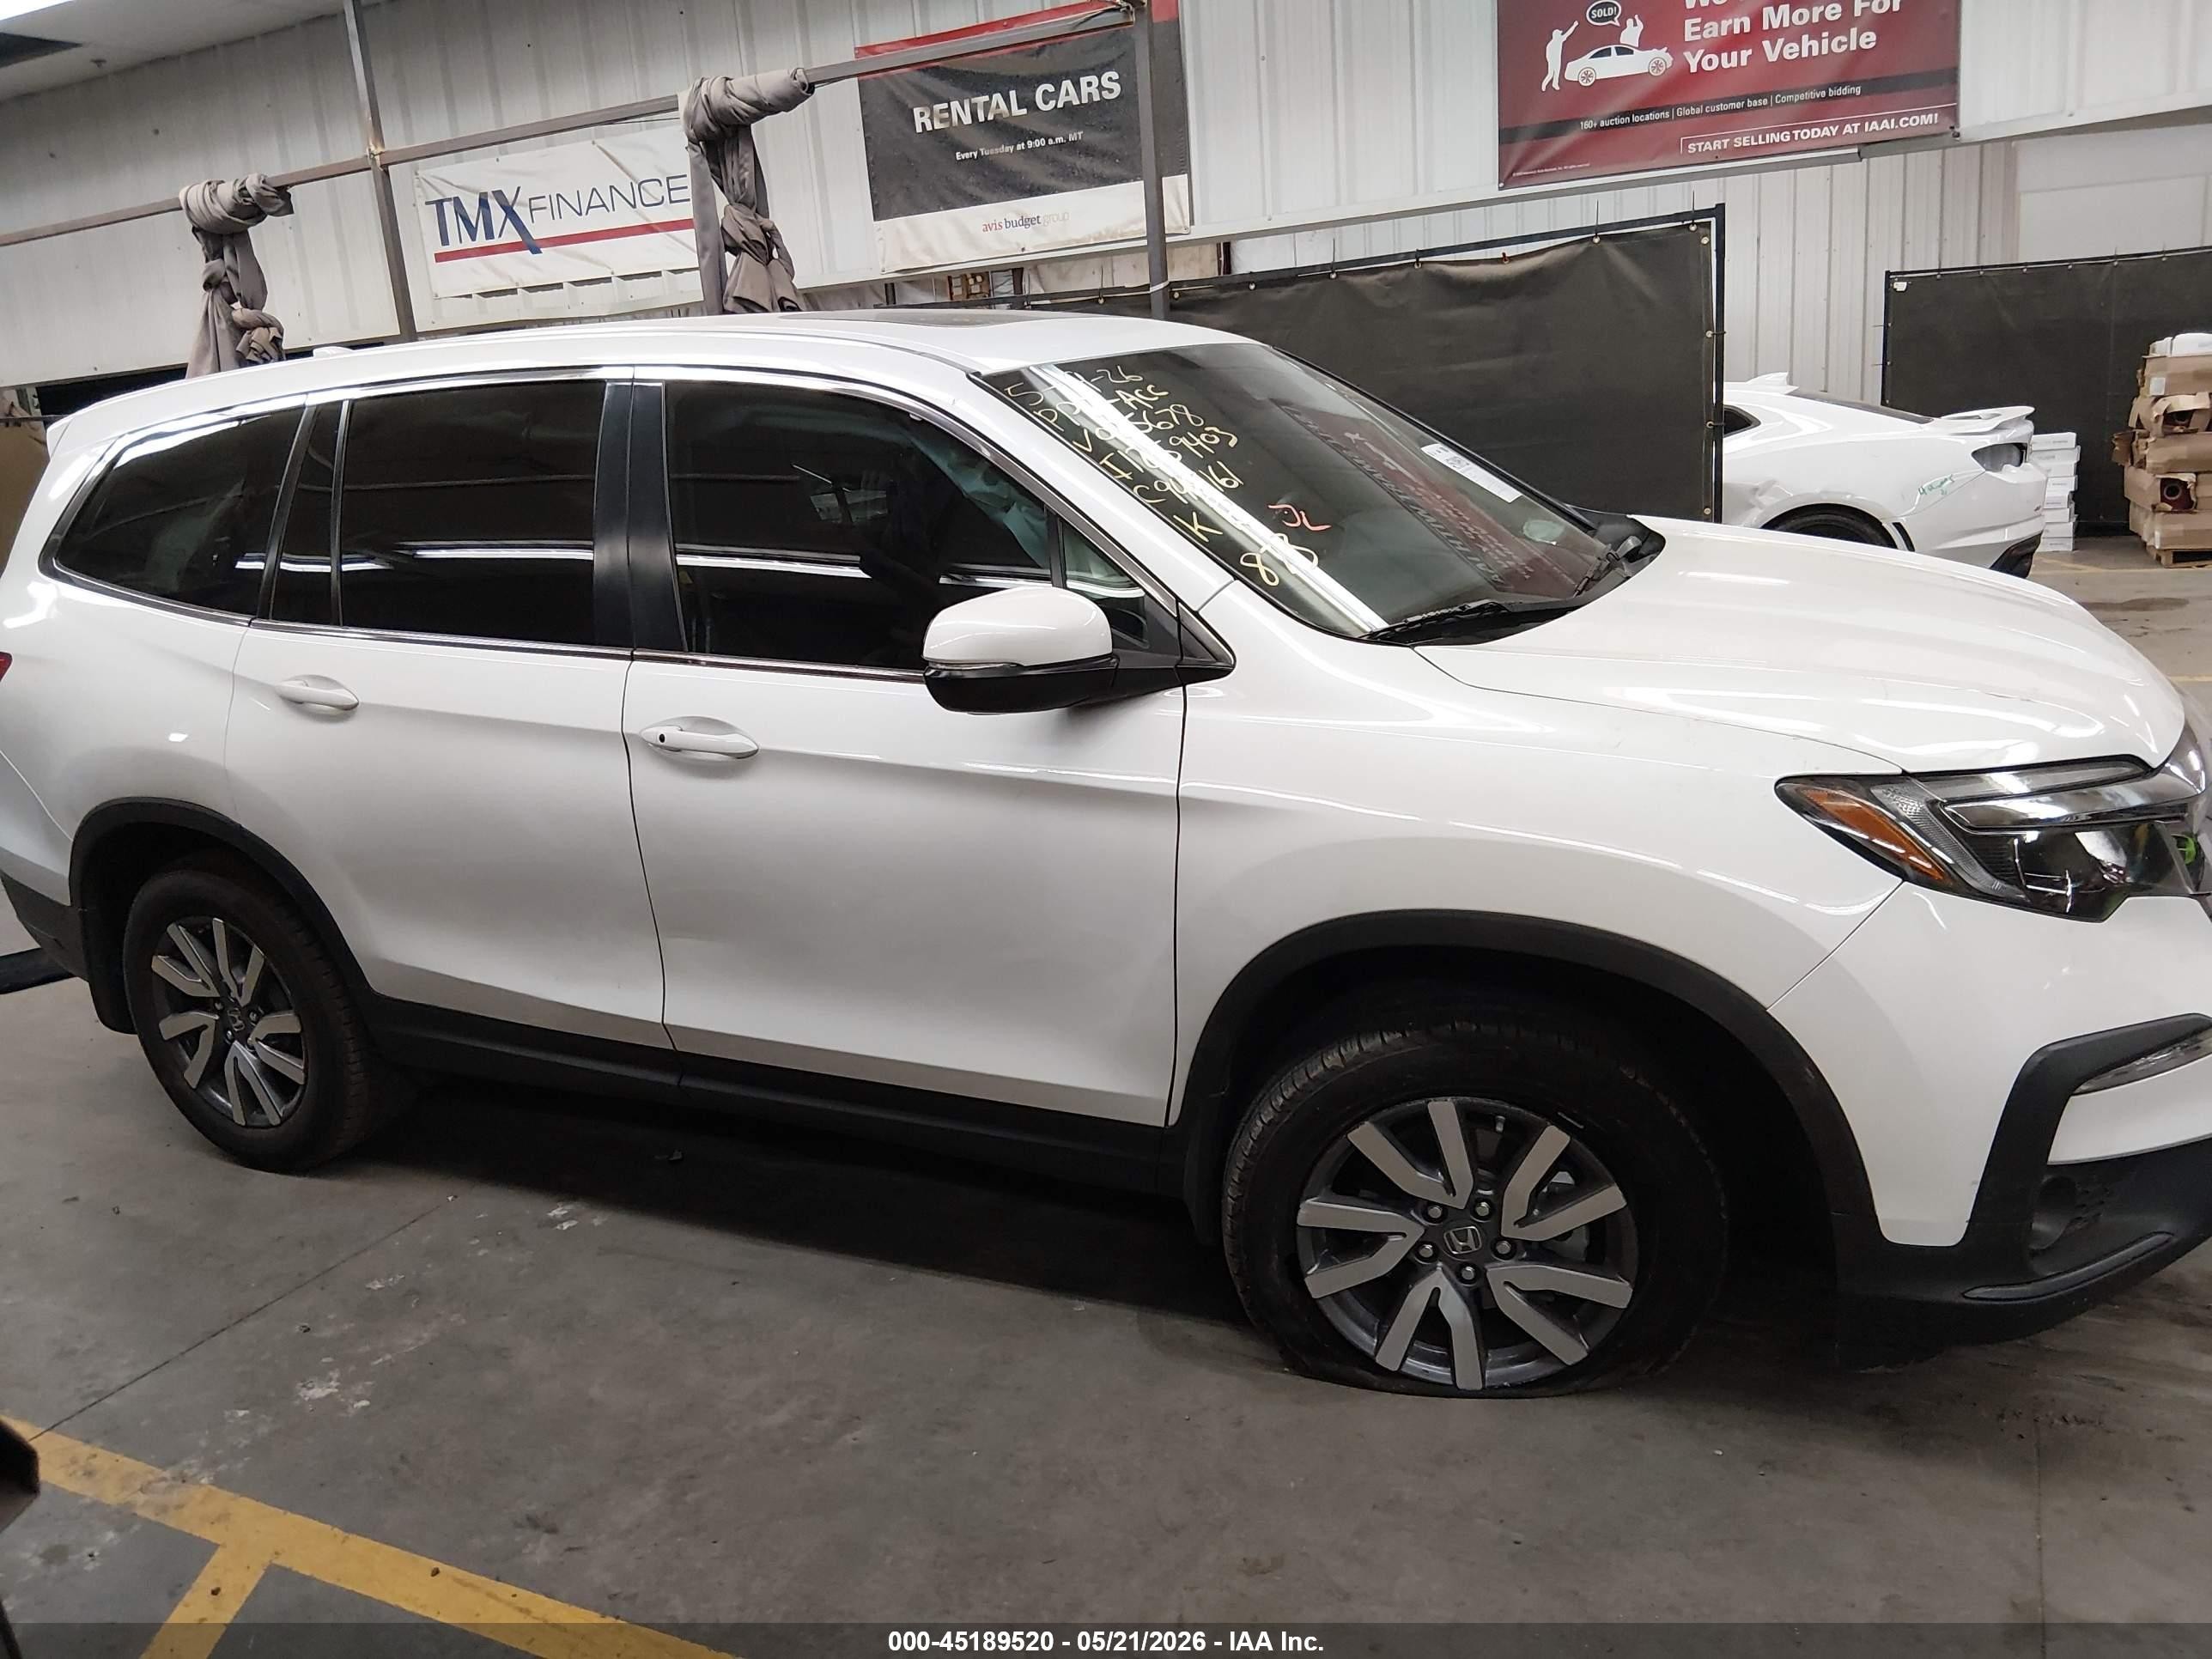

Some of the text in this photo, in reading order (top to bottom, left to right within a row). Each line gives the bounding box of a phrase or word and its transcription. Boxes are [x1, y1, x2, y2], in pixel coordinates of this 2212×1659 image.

[1591, 7, 1617, 19] SOLD!
[1684, 0, 1901, 42] Earn More For
[1683, 27, 1877, 73] Your Vehicle
[913, 70, 1121, 133] RENTAL CARS
[1580, 120, 1597, 130] 160+
[1600, 115, 1630, 127] auction
[1632, 110, 1669, 123] locations
[1676, 105, 1703, 117] Global
[1705, 100, 1744, 112] customer
[1747, 98, 1768, 106] base
[1775, 89, 1826, 104] Competitive
[1828, 85, 1862, 97] bidding
[956, 131, 1084, 161] Every Tuesday at 9:00 a.m. MT
[1687, 112, 1939, 153] START SELLING TODAY AT IAAI.COM!
[424, 174, 690, 255] TMX FINANCE
[981, 210, 1070, 233] avis budget group
